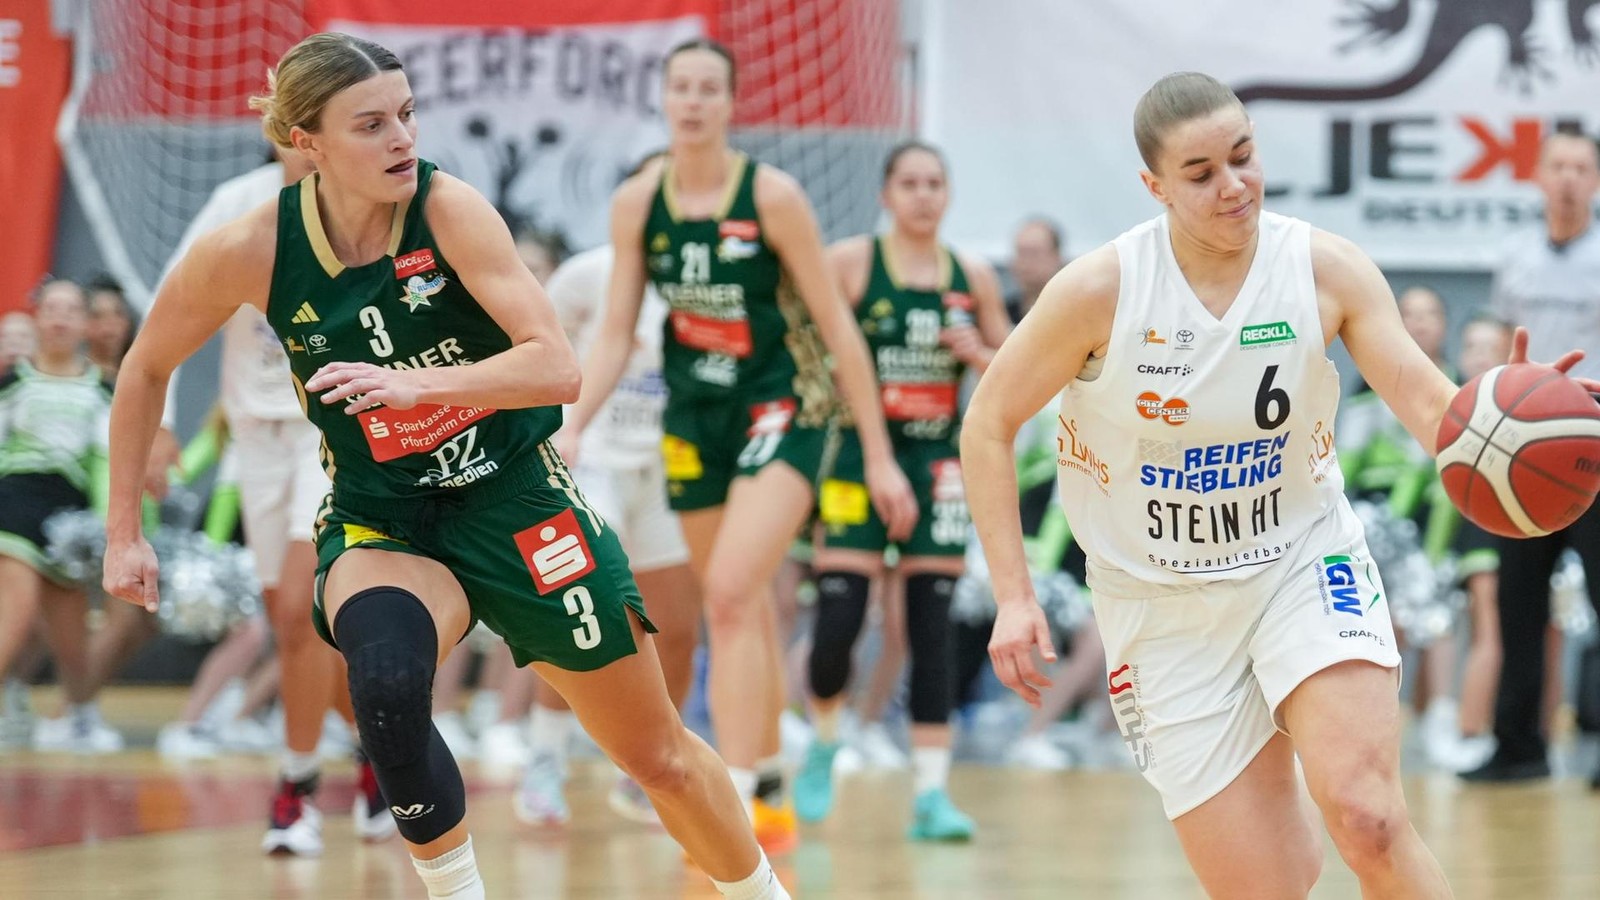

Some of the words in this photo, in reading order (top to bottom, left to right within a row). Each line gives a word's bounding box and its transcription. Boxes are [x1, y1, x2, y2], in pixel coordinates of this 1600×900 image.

[402, 32, 664, 116] EERFORC
[680, 241, 711, 283] 21
[358, 305, 394, 358] 3
[1242, 325, 1287, 342] RECKLI
[1137, 364, 1181, 376] CRAFT
[1254, 364, 1291, 430] 6
[394, 404, 452, 434] Sparkasse
[400, 420, 459, 450] Pforzheim
[430, 425, 487, 480] PZ
[1184, 430, 1291, 472] REIFEN
[438, 460, 500, 488] medien
[1140, 453, 1283, 494] STIEBLING
[1147, 499, 1241, 544] STEIN
[1251, 487, 1283, 537] HT
[1148, 542, 1292, 568] Spezialtiefbau
[562, 585, 602, 651] 3
[1339, 630, 1378, 641] CRAFT
